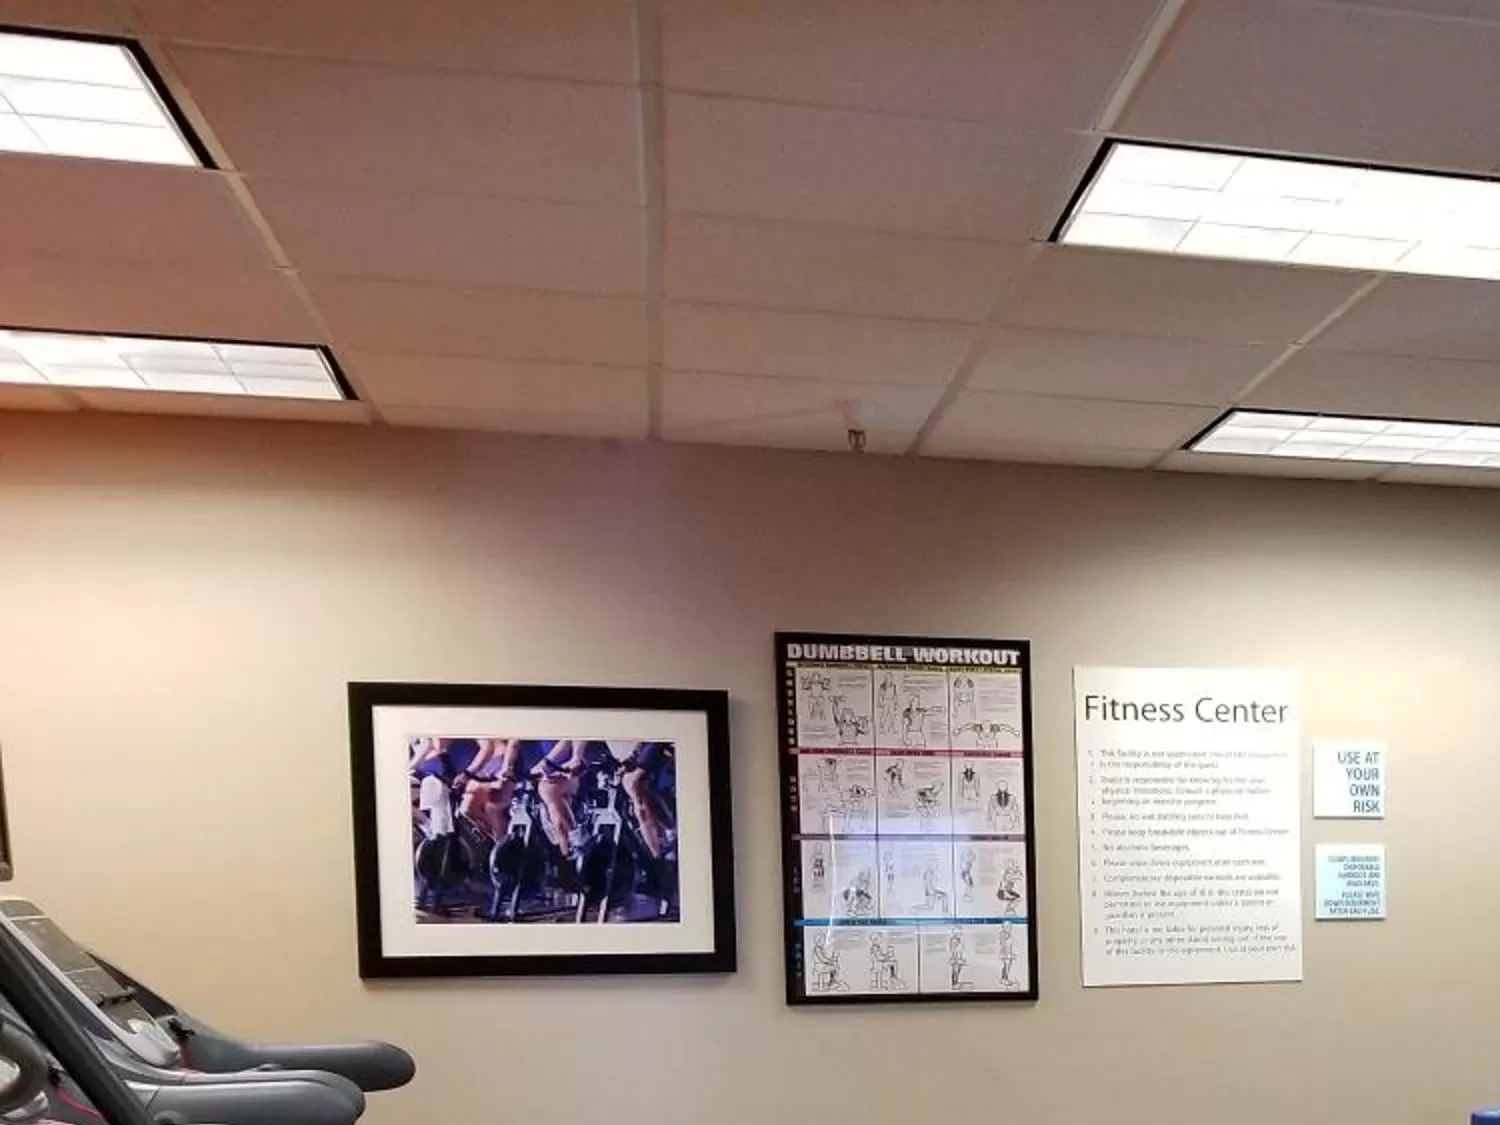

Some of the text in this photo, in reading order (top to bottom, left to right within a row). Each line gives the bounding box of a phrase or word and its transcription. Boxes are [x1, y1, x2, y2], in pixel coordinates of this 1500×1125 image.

[787, 643, 1020, 665] DUMBBELL WORKOUT
[1084, 695, 1288, 723] Fitness Center
[1337, 751, 1380, 765] USE AT
[1345, 767, 1379, 781] YOUR
[1349, 783, 1380, 797] OWN
[1353, 799, 1380, 813] RISK
